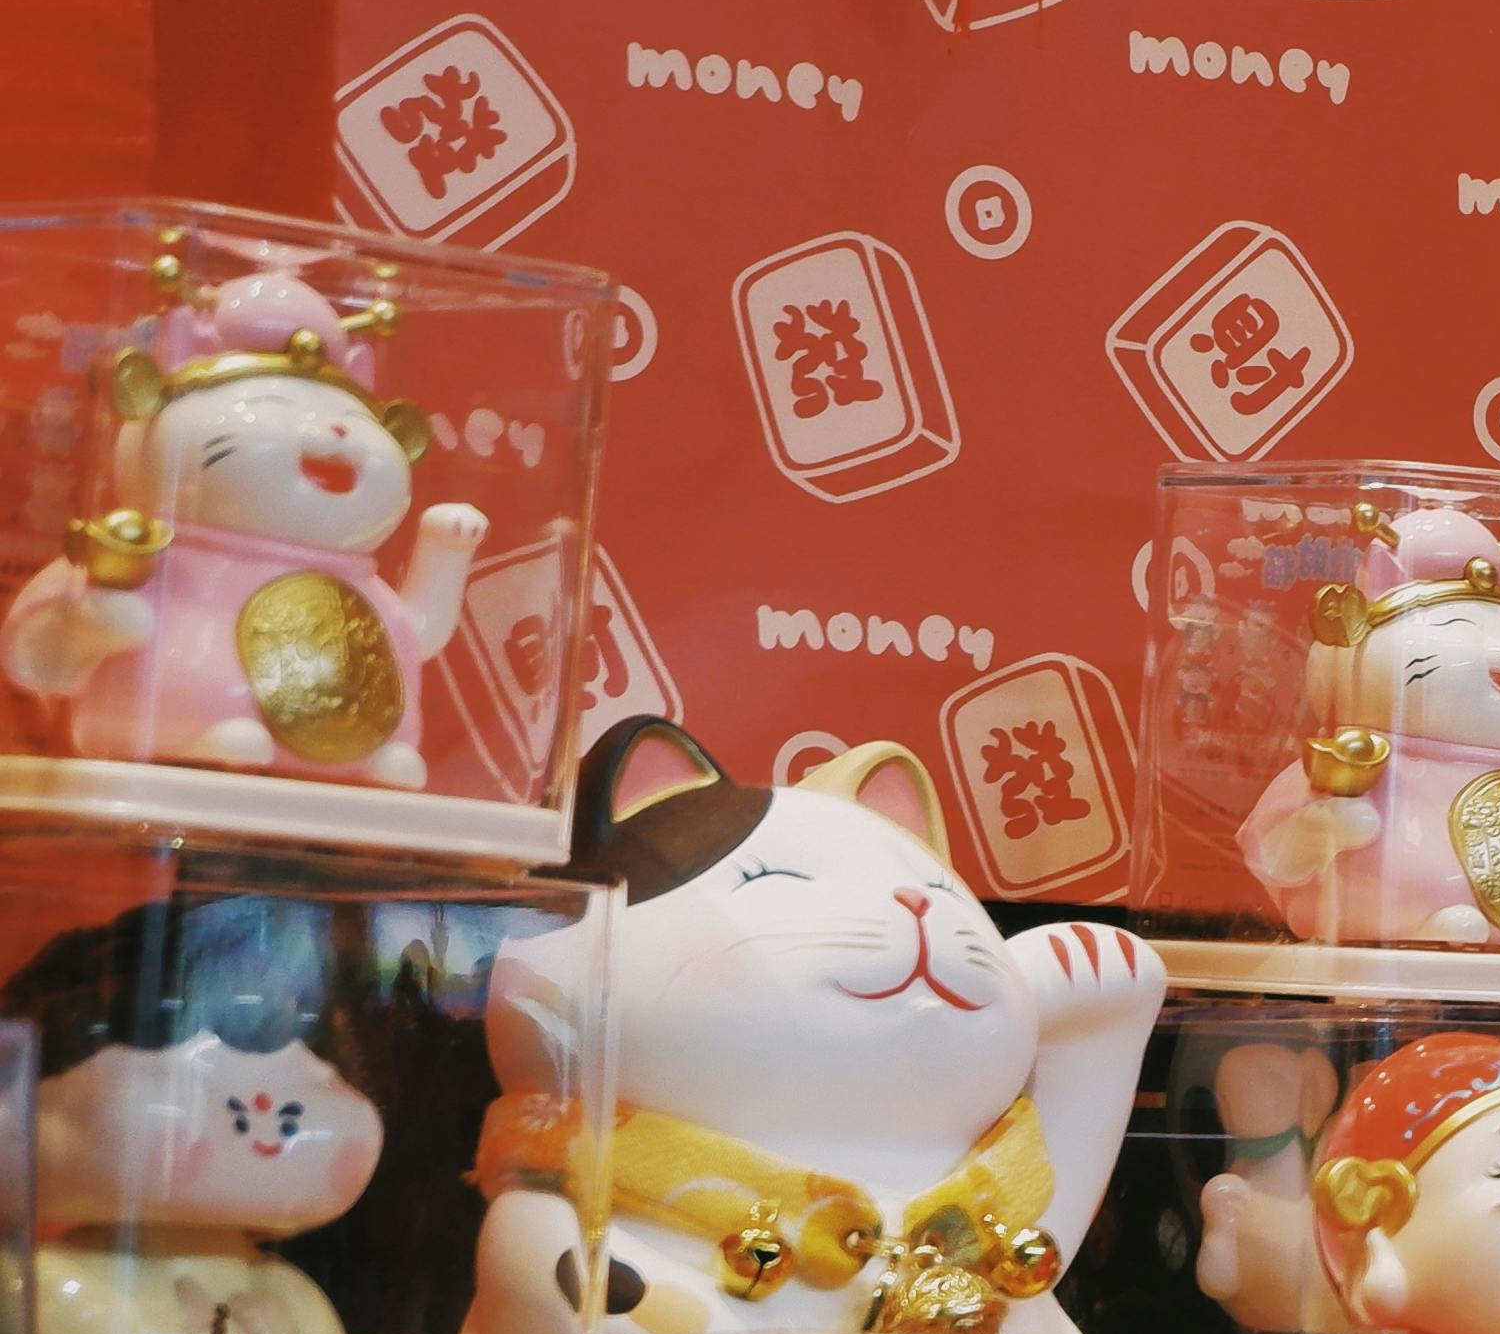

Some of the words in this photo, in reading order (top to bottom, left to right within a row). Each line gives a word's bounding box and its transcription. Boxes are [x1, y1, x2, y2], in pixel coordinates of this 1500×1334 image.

[626, 41, 864, 123] money
[1128, 29, 1351, 105] money
[380, 67, 506, 199] 發
[773, 300, 882, 418] 發
[1190, 294, 1311, 415] 財
[754, 603, 995, 672] money
[981, 720, 1091, 840] 發
